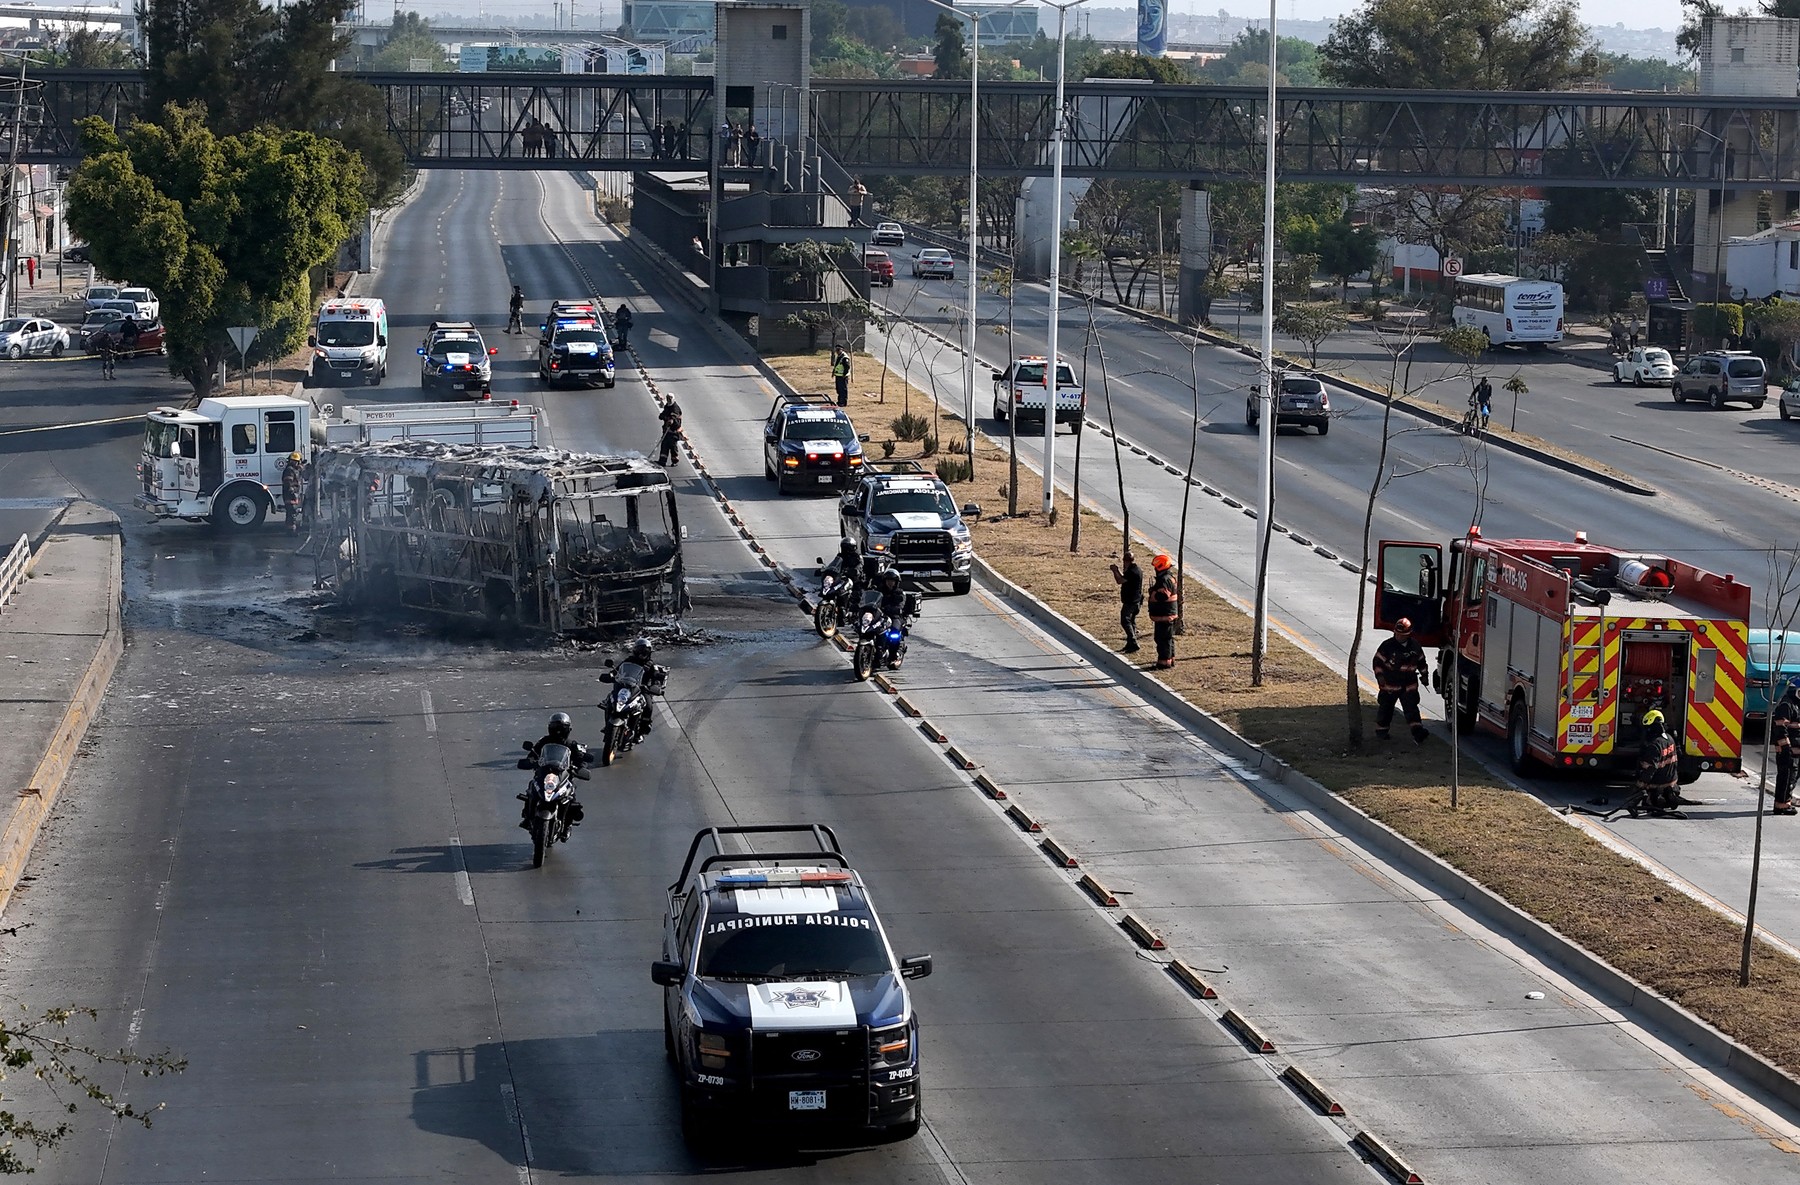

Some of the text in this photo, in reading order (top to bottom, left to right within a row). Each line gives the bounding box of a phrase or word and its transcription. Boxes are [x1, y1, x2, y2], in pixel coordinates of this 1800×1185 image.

[796, 1050, 816, 1060] Ford
[698, 1074, 724, 1085] ZP-0730
[889, 1068, 913, 1080] ZP-0730
